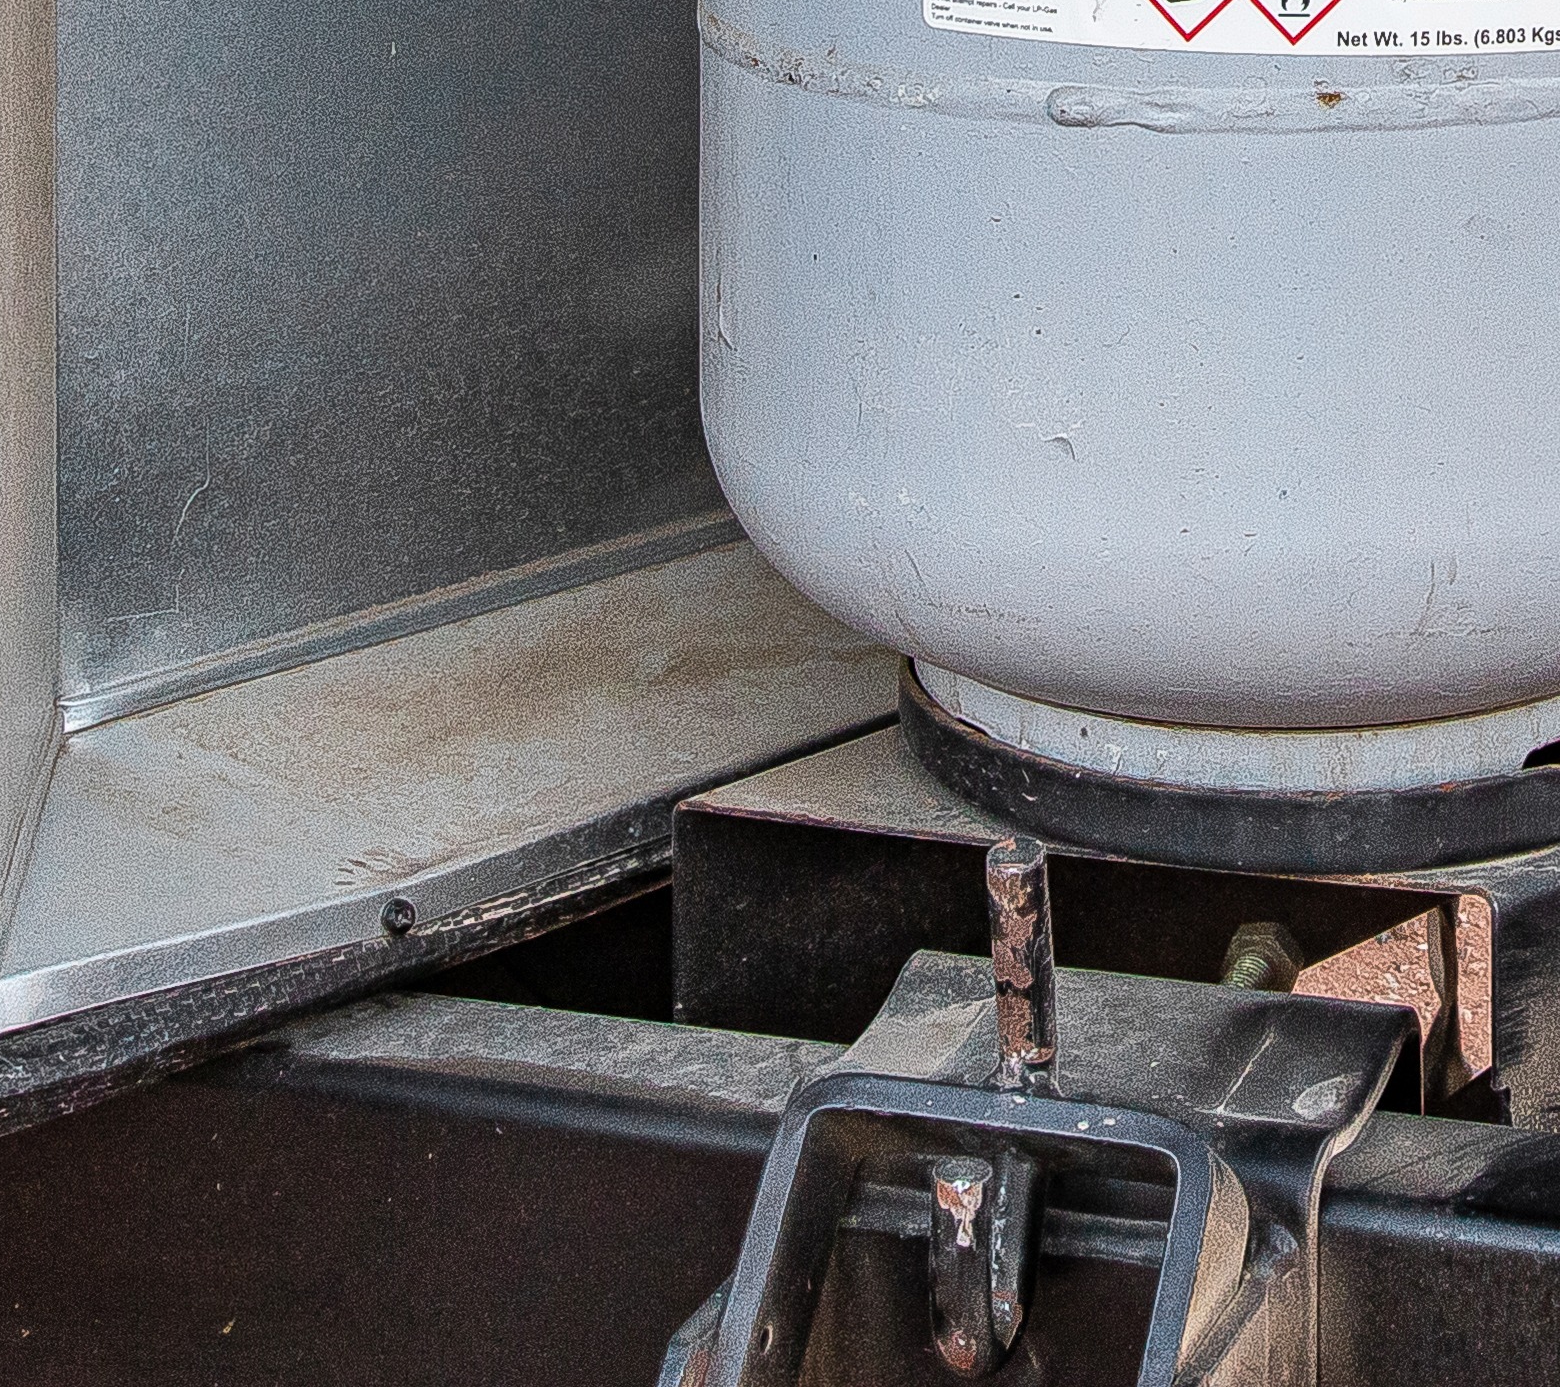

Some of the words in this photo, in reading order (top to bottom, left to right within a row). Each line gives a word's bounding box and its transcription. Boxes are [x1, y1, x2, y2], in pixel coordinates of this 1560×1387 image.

[1337, 31, 1367, 47] Net
[1373, 31, 1403, 47] Wt.
[1410, 31, 1430, 47] 15
[1436, 30, 1467, 46] lbs.
[1474, 28, 1525, 48] (6.803
